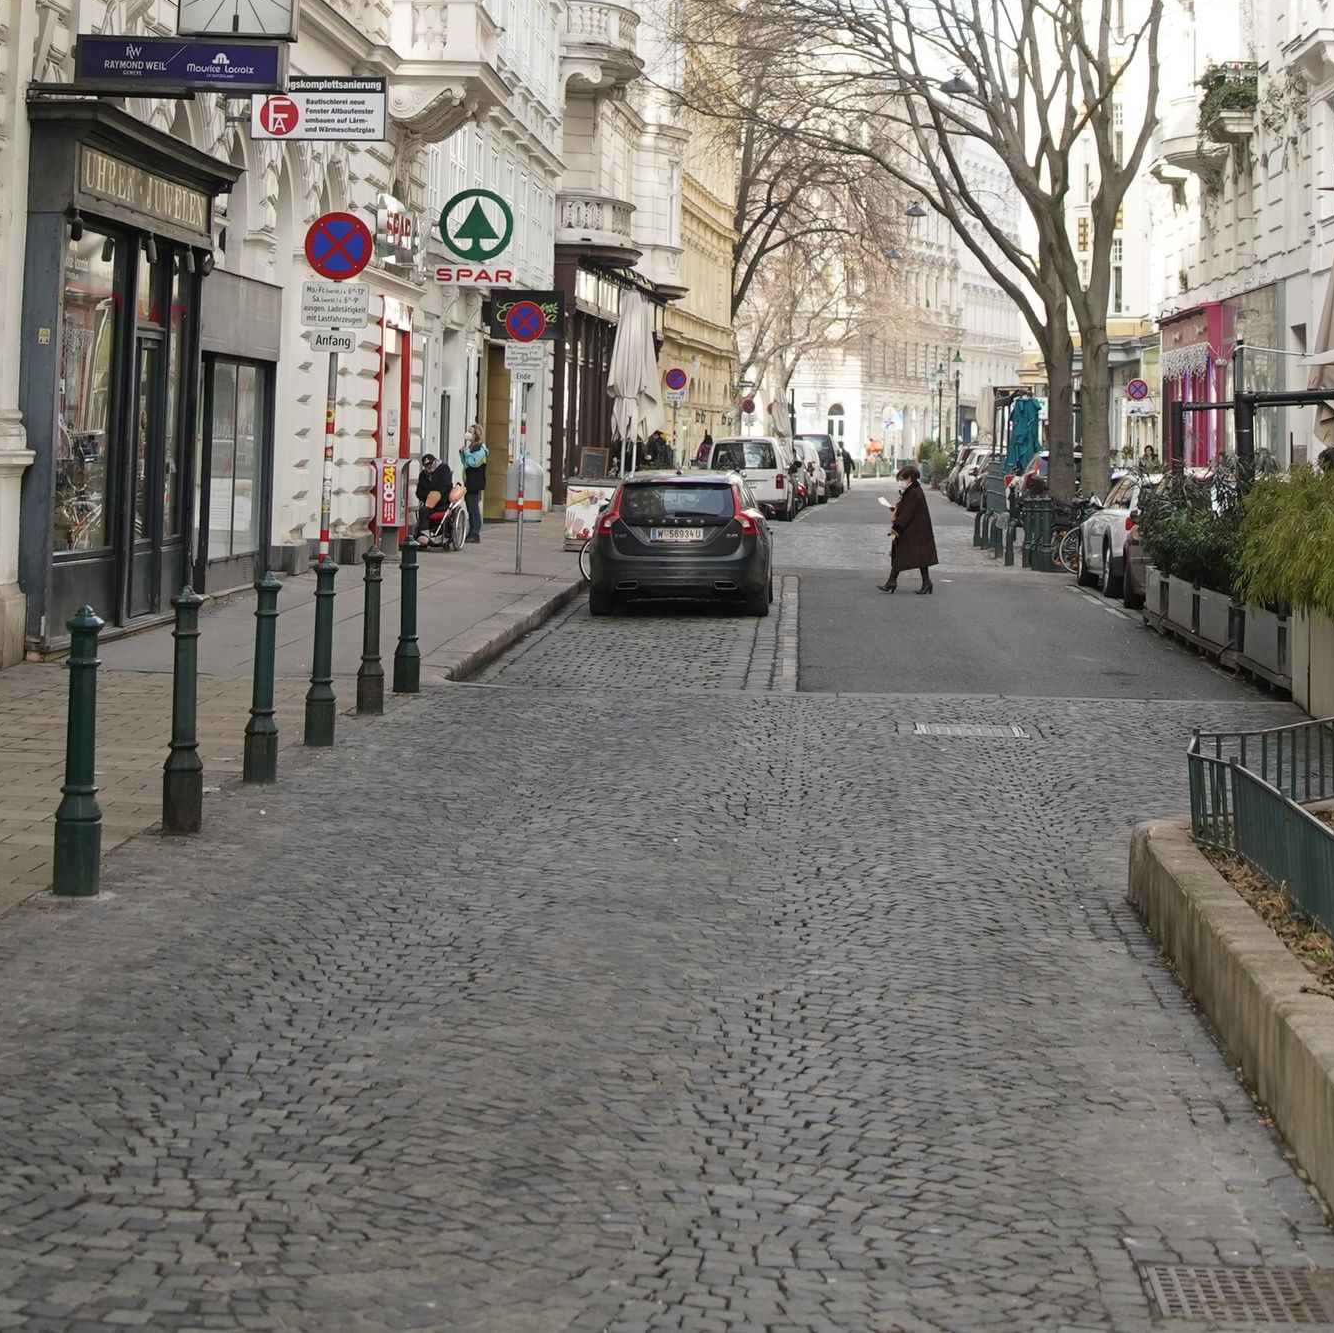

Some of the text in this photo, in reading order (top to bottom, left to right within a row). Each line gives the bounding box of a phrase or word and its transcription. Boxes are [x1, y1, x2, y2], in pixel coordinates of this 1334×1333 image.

[104, 60, 167, 71] RAYMOND WEIL
[187, 63, 254, 74] Maurice Lacroix
[306, 98, 348, 106] Bautischlerei
[319, 126, 375, 135] Wärmeschutzglas
[86, 152, 204, 227] UHREN JUWELEN
[436, 268, 512, 283] SPAR
[328, 306, 366, 314] Ladetätigkeit
[318, 315, 363, 326] Lastfahrzeugen
[315, 334, 351, 349] Anfang
[516, 372, 531, 380] Ende
